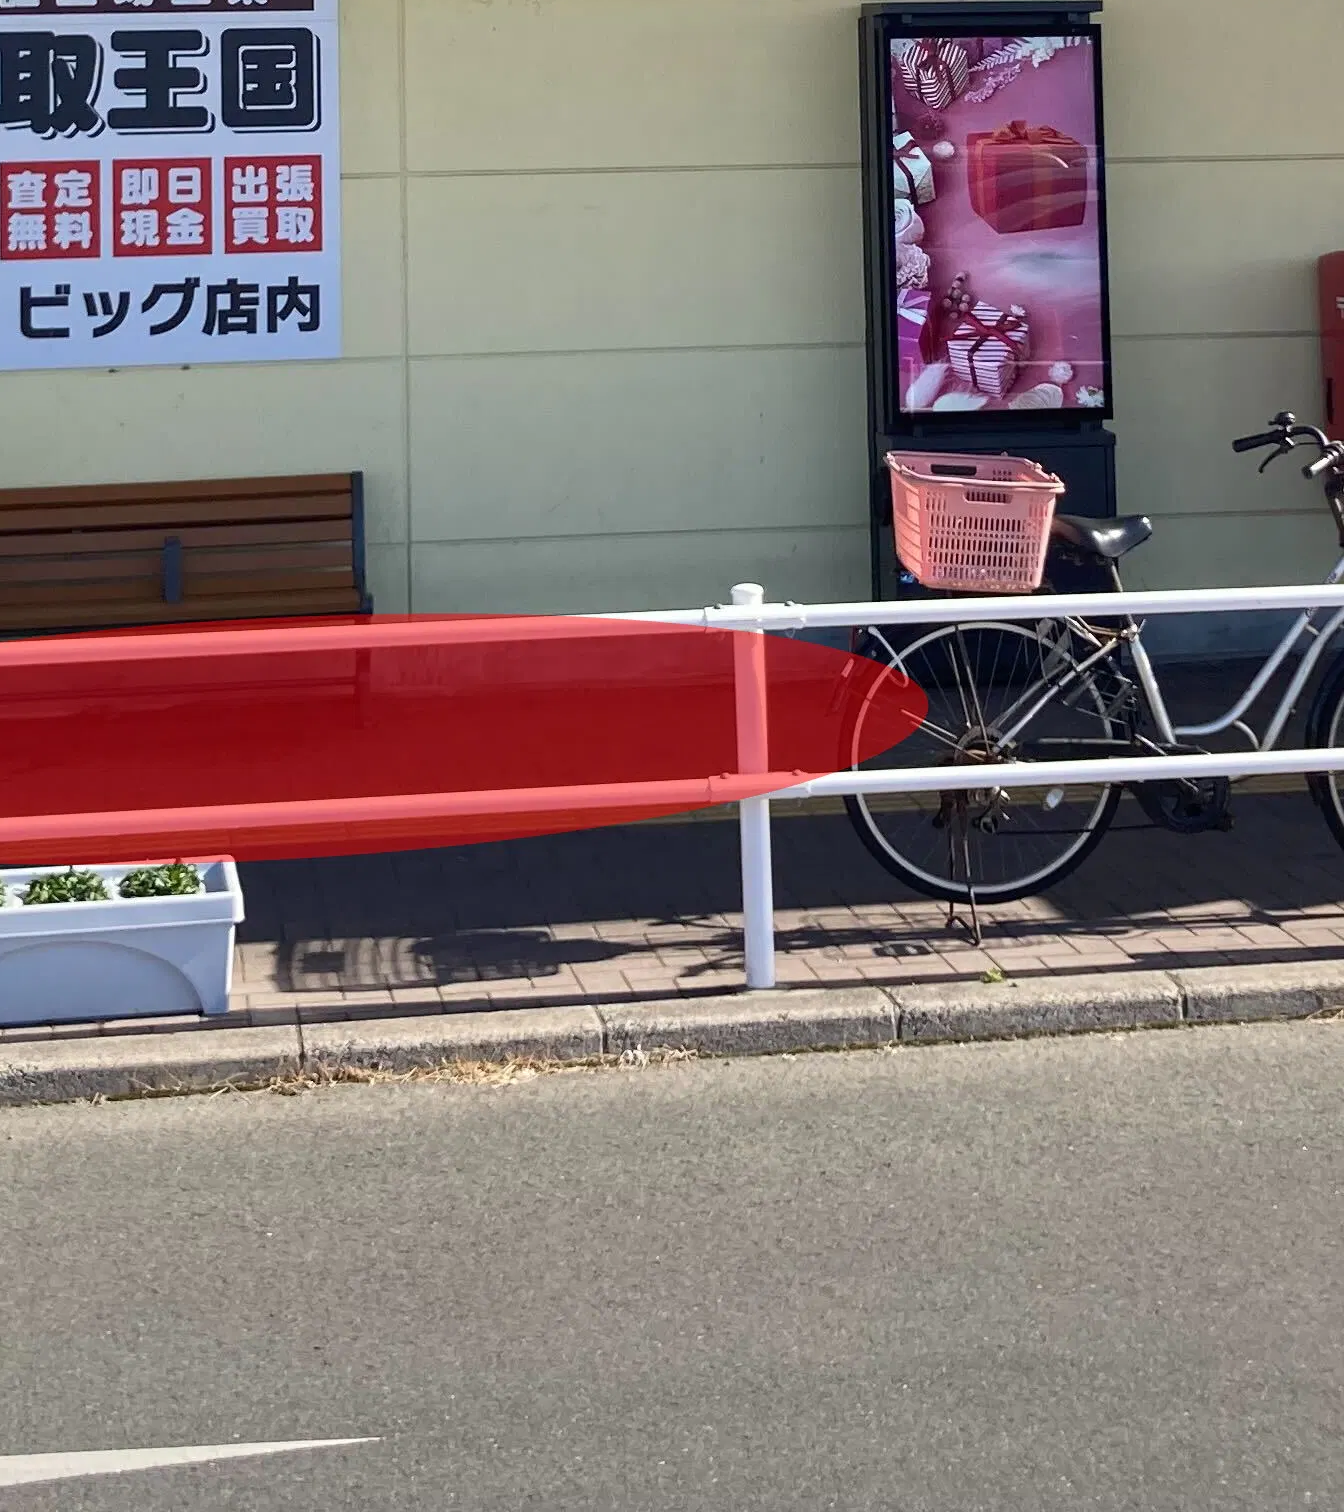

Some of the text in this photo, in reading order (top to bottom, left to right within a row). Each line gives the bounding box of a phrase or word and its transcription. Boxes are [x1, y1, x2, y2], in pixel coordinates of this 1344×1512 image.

[6, 169, 93, 209] 査定
[120, 166, 204, 205] 即日
[231, 164, 315, 203] 出張
[6, 211, 93, 251] 無料
[119, 207, 206, 247] 現金
[231, 205, 315, 245] 買取
